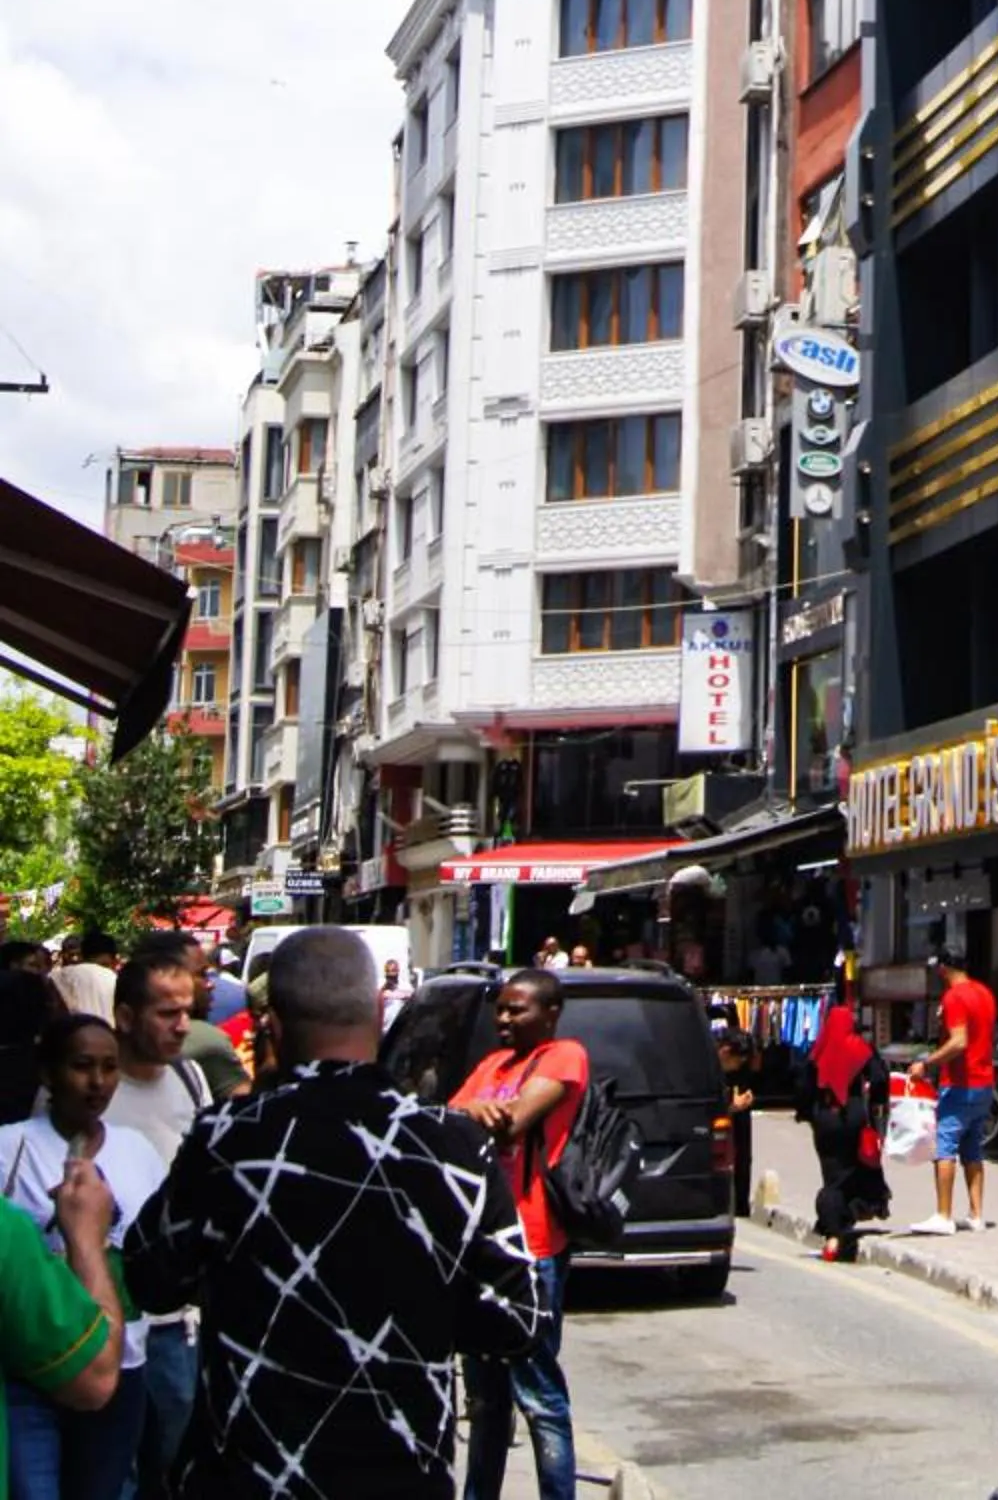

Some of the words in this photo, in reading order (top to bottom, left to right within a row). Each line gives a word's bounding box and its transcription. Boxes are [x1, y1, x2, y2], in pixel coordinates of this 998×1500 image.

[708, 655, 731, 745] HOTEL
[847, 763, 909, 850] HOTEL
[909, 741, 981, 838] GRAND
